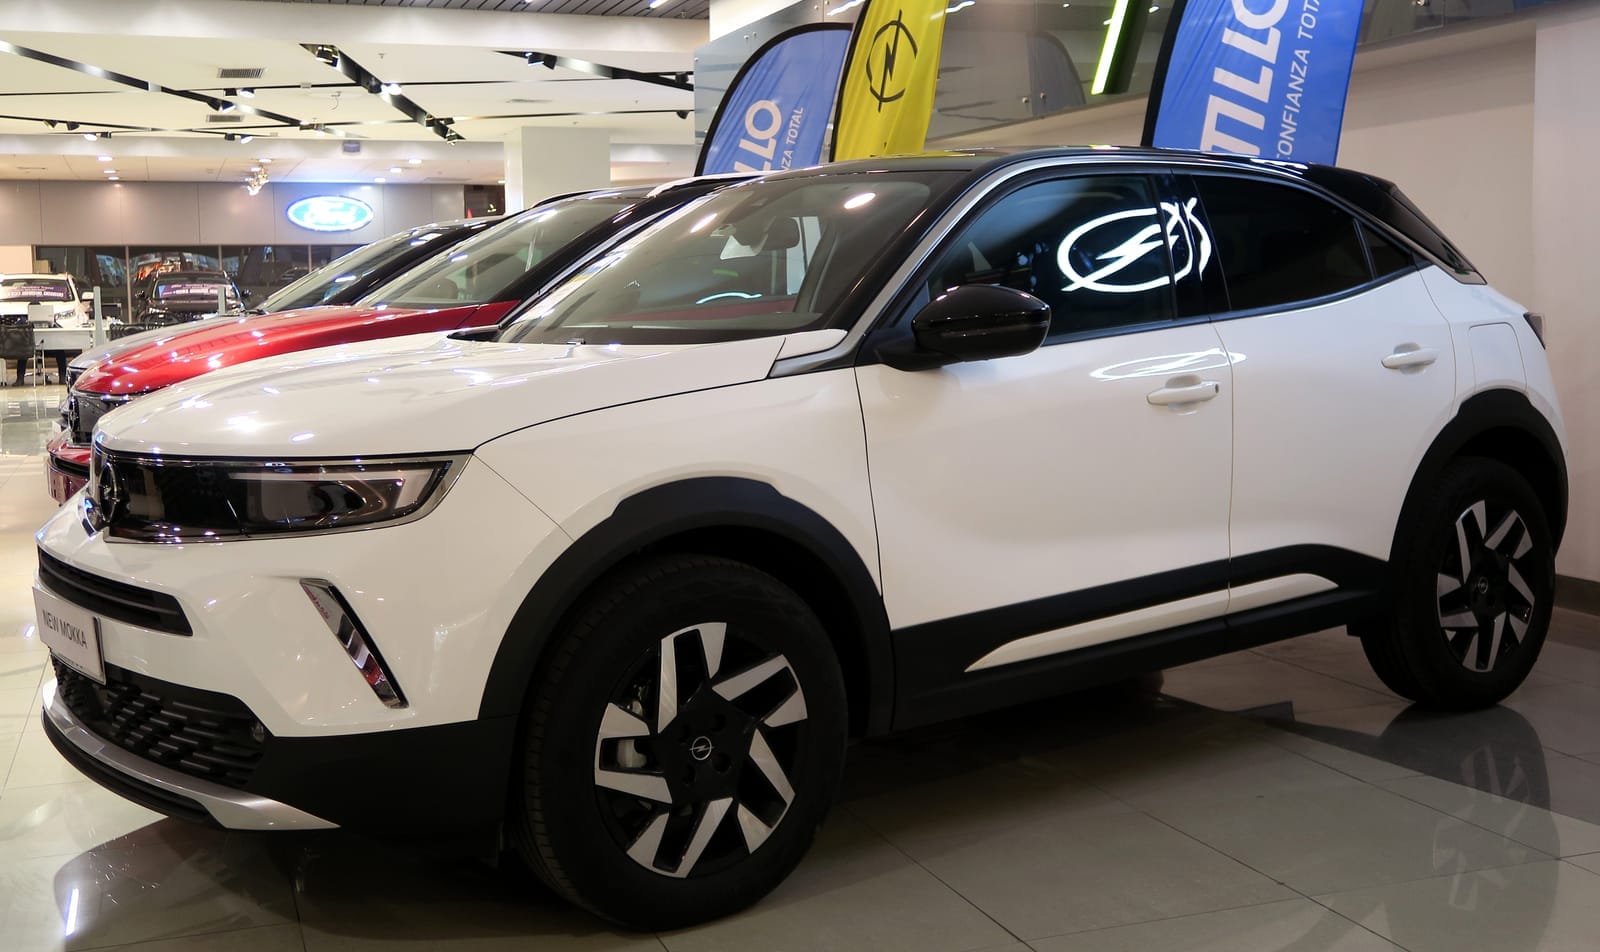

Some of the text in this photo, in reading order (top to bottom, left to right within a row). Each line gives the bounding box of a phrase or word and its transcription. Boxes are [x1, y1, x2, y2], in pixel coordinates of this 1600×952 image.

[1276, 0, 1320, 159] ONFIANZA TOT
[786, 107, 804, 145] TOTAL
[43, 609, 88, 649] NEW MOKKA
